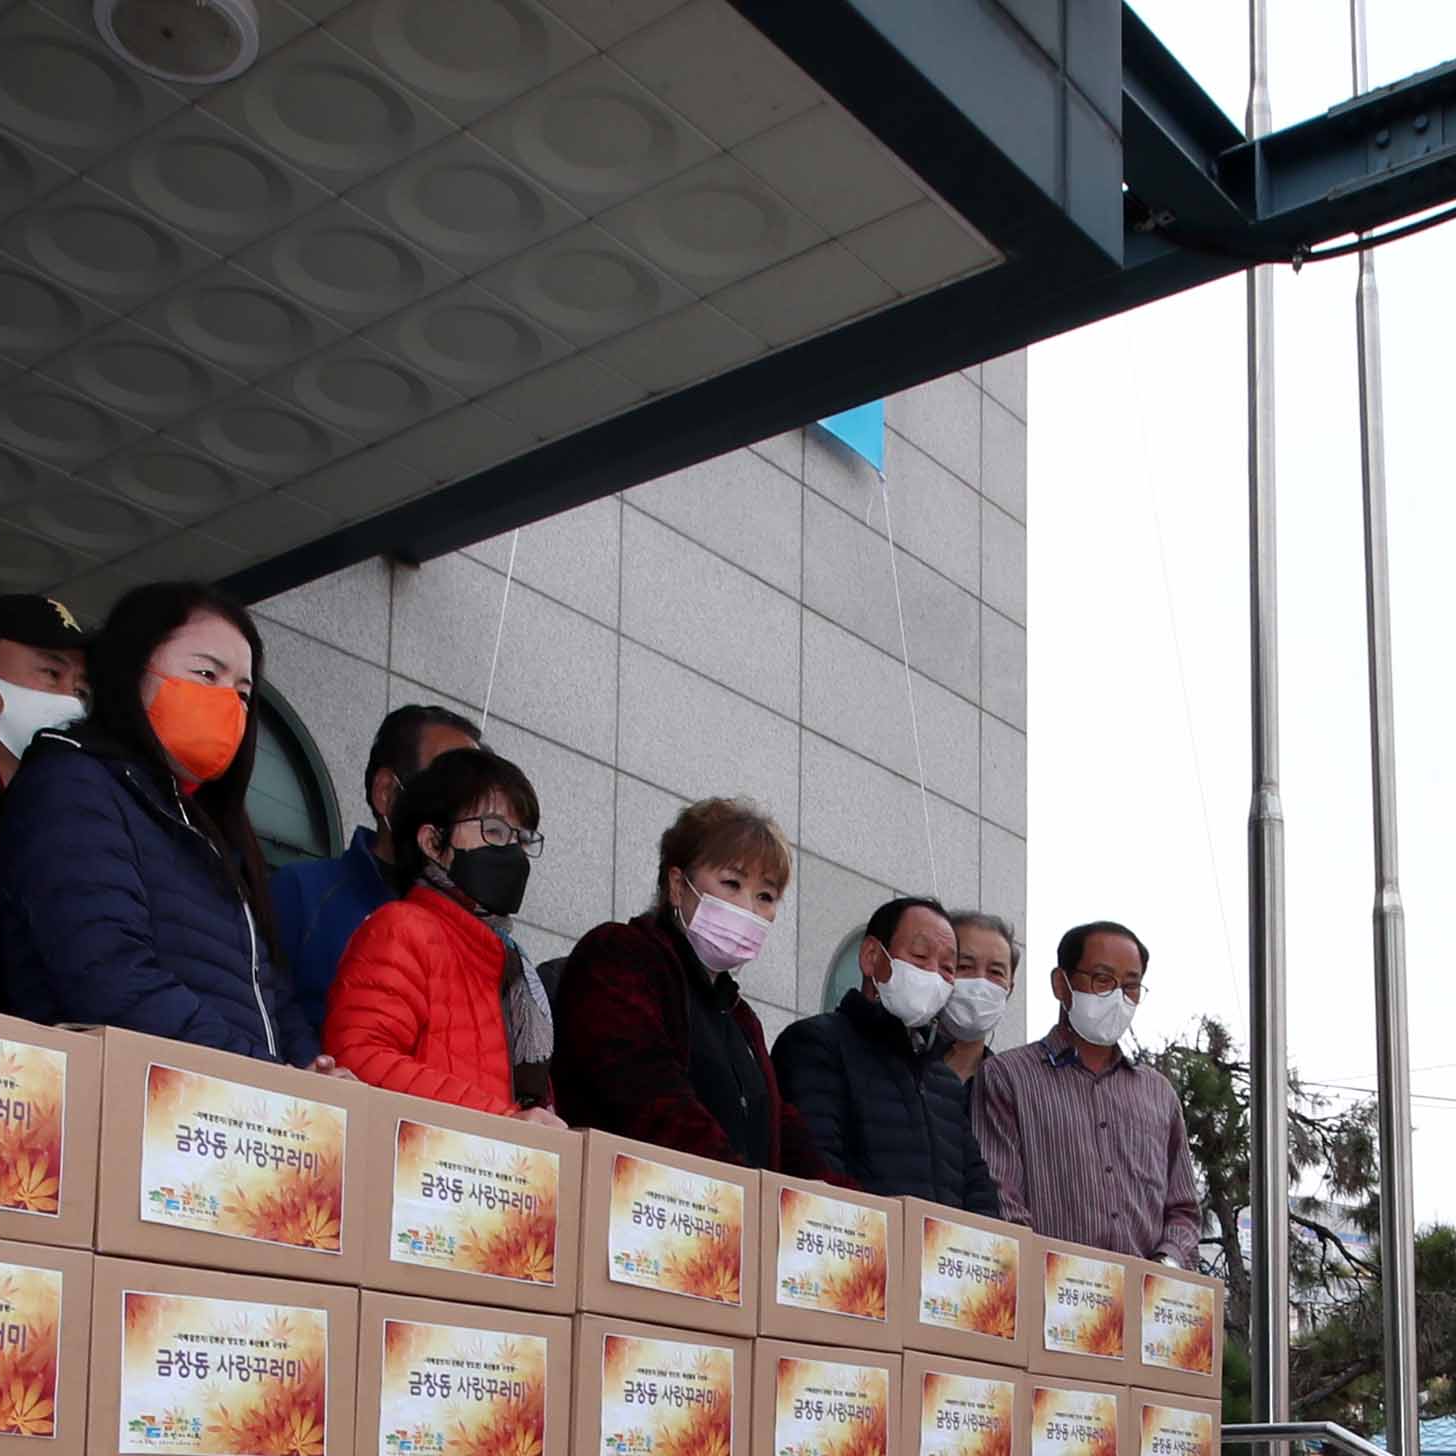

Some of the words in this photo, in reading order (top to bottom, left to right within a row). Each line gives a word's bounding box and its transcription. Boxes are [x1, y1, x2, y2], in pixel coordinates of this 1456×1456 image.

[175, 1123, 230, 1162] 금창동
[234, 1137, 320, 1178] 사랑꾸러미
[420, 1171, 466, 1205] 금창동
[468, 1183, 539, 1218] 사랑꾸러미
[631, 1200, 669, 1232] 금창동
[670, 1211, 728, 1244] 사랑꾸러미
[155, 1348, 212, 1382] 금창동
[216, 1354, 304, 1385] 사랑꾸러미
[408, 1370, 454, 1401] 금창동
[456, 1376, 527, 1405] 사랑꾸러미
[623, 1379, 660, 1407] 금창동
[661, 1384, 718, 1411] 사랑꾸러미
